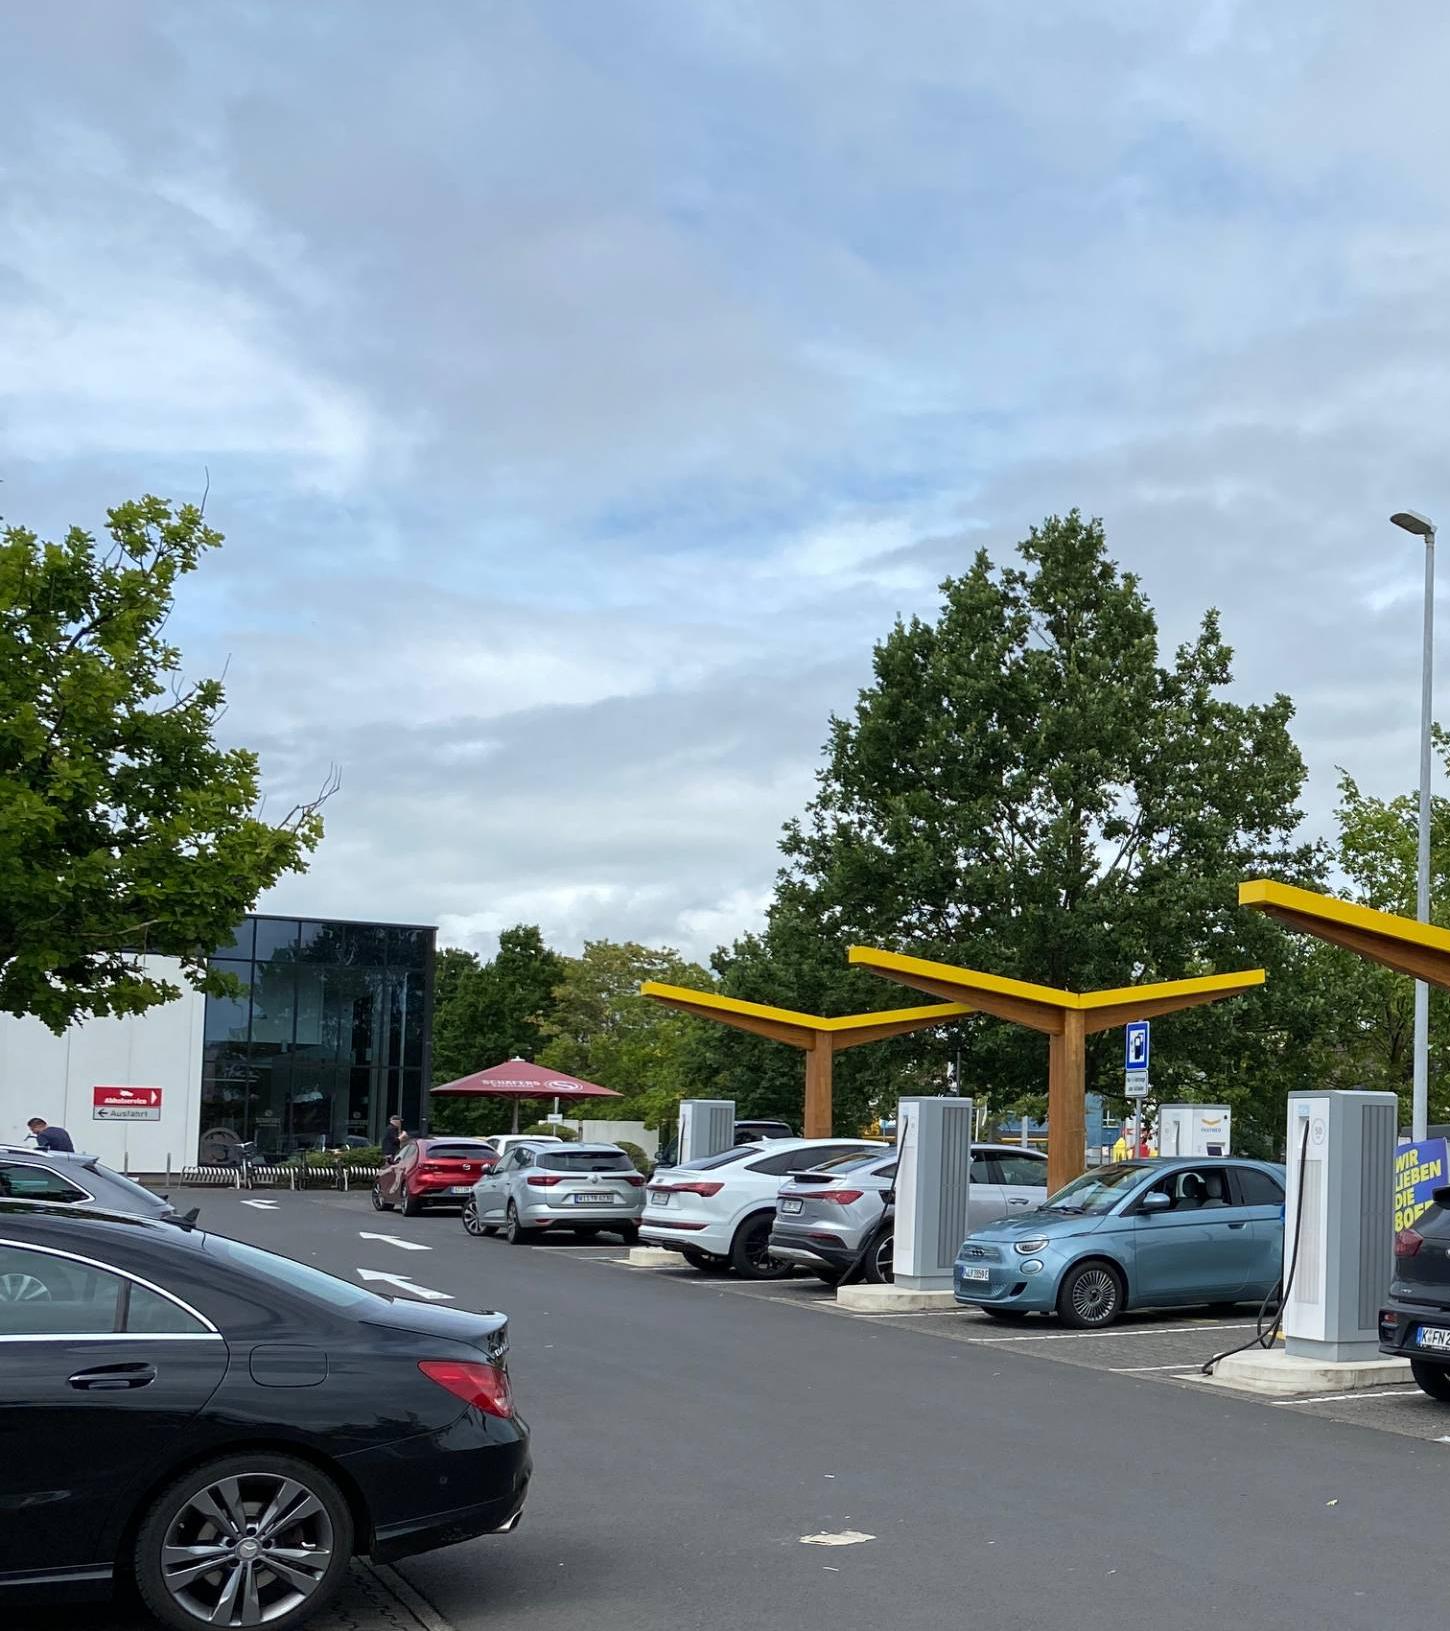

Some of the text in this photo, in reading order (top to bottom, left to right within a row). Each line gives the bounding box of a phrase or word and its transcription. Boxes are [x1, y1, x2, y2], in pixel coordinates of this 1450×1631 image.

[1396, 1149, 1418, 1173] WIR
[1396, 1159, 1441, 1193] LIEBEN
[1395, 1187, 1415, 1210] DIE
[1422, 1329, 1429, 1342] K
[1432, 1330, 1446, 1345] FN
